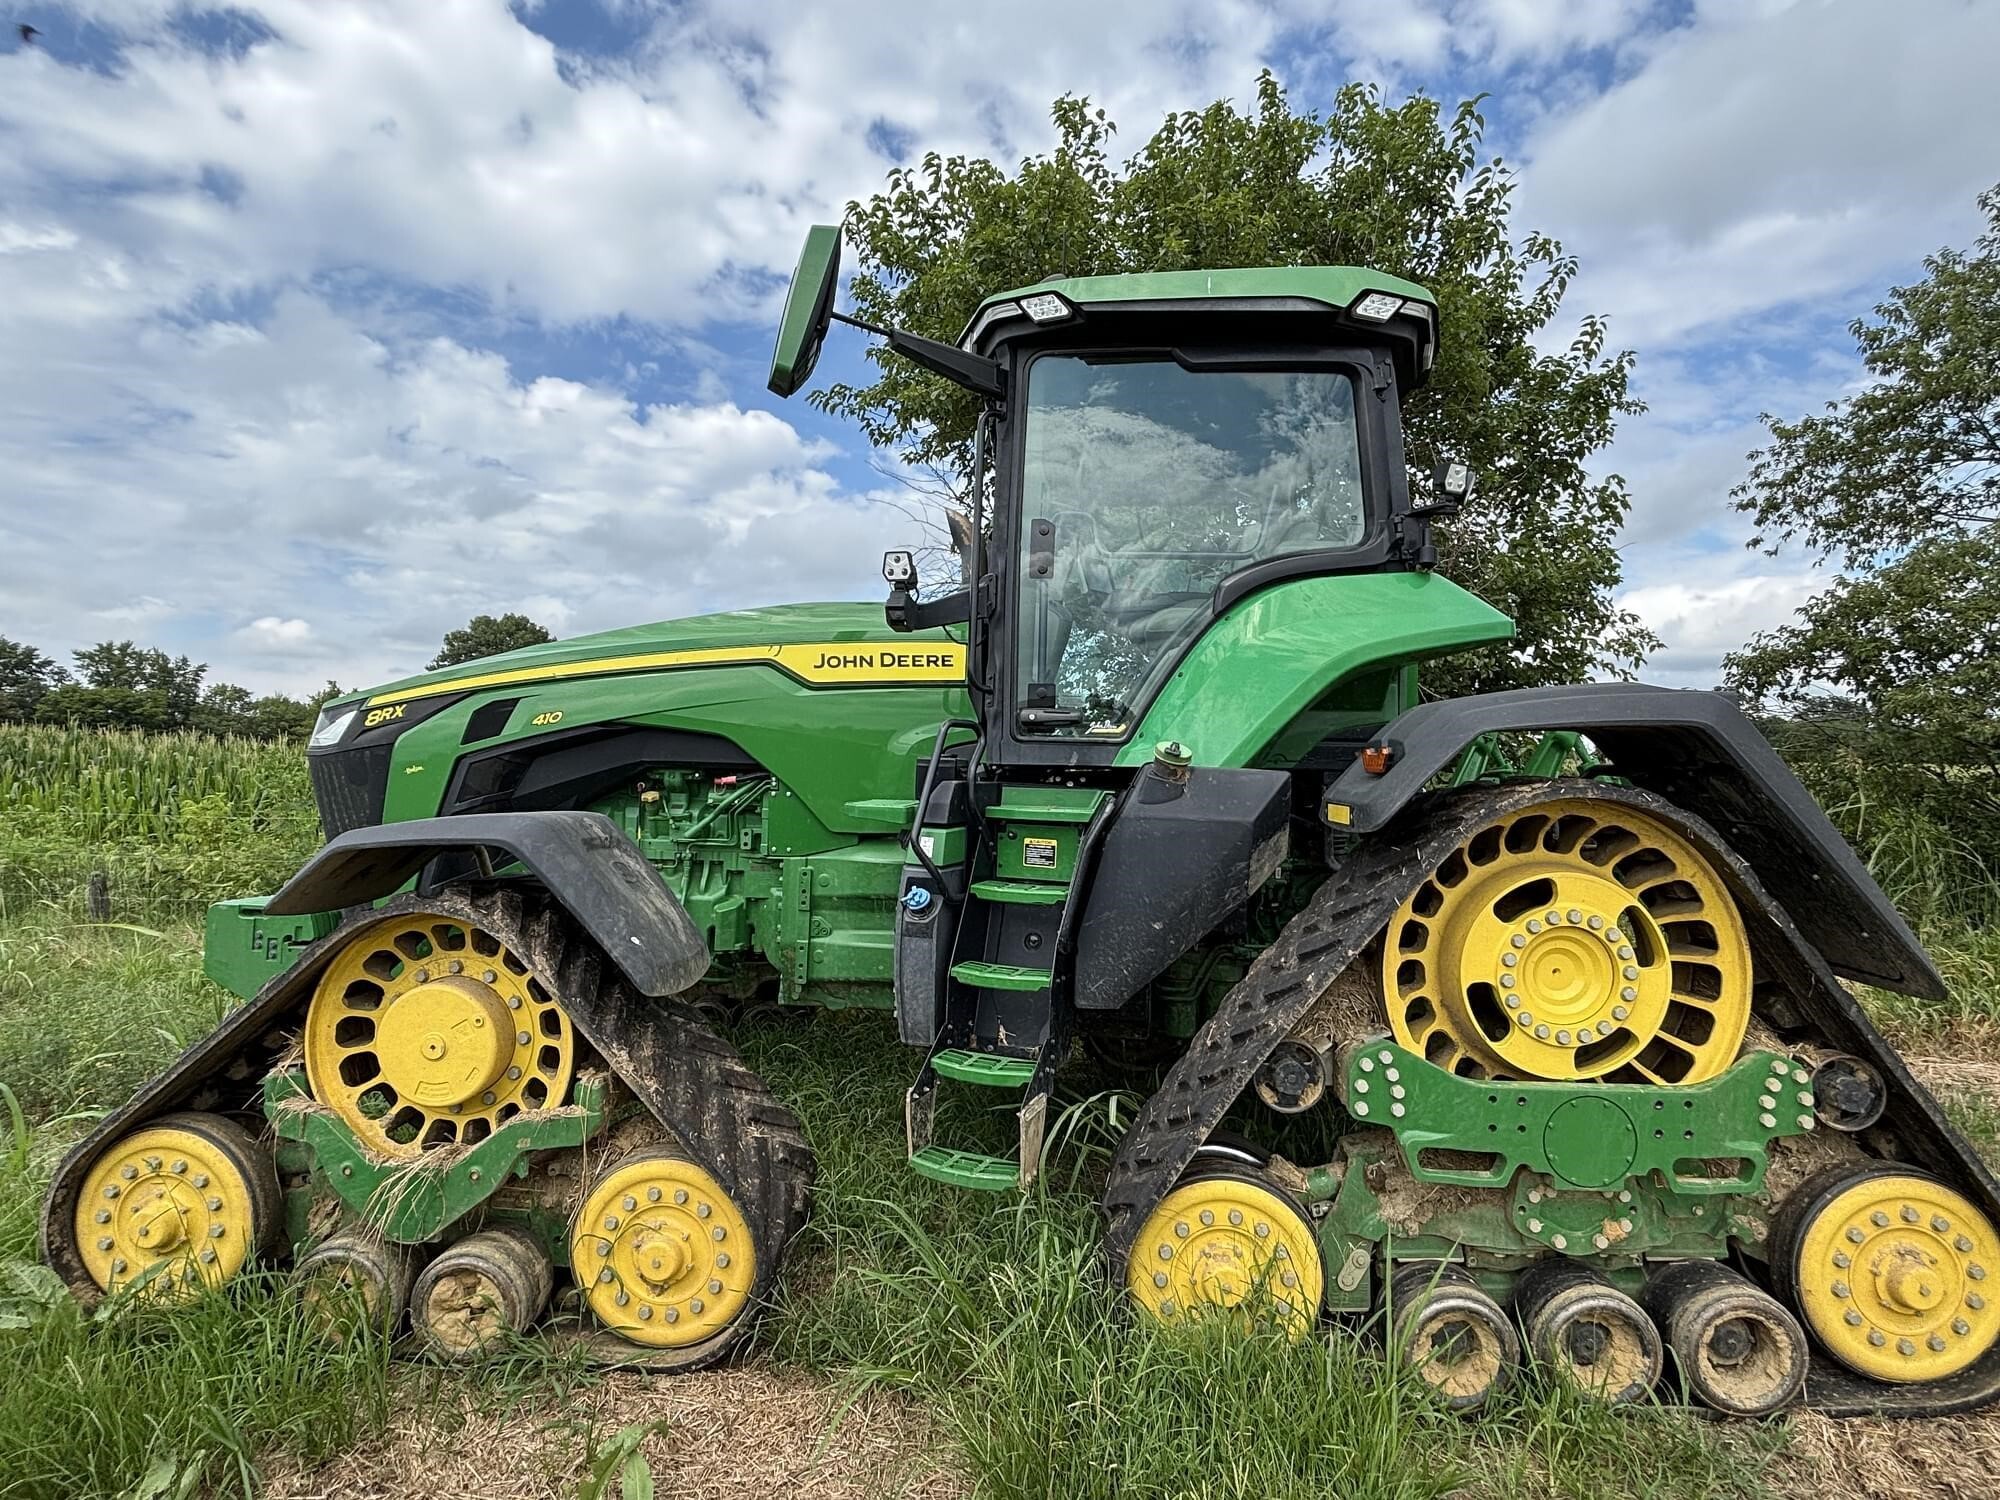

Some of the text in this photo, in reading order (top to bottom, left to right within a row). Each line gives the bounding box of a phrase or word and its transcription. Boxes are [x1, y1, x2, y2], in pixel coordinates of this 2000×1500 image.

[813, 652, 954, 669] JOHN DEERE
[364, 703, 408, 727] 8RX
[531, 710, 563, 726] 410
